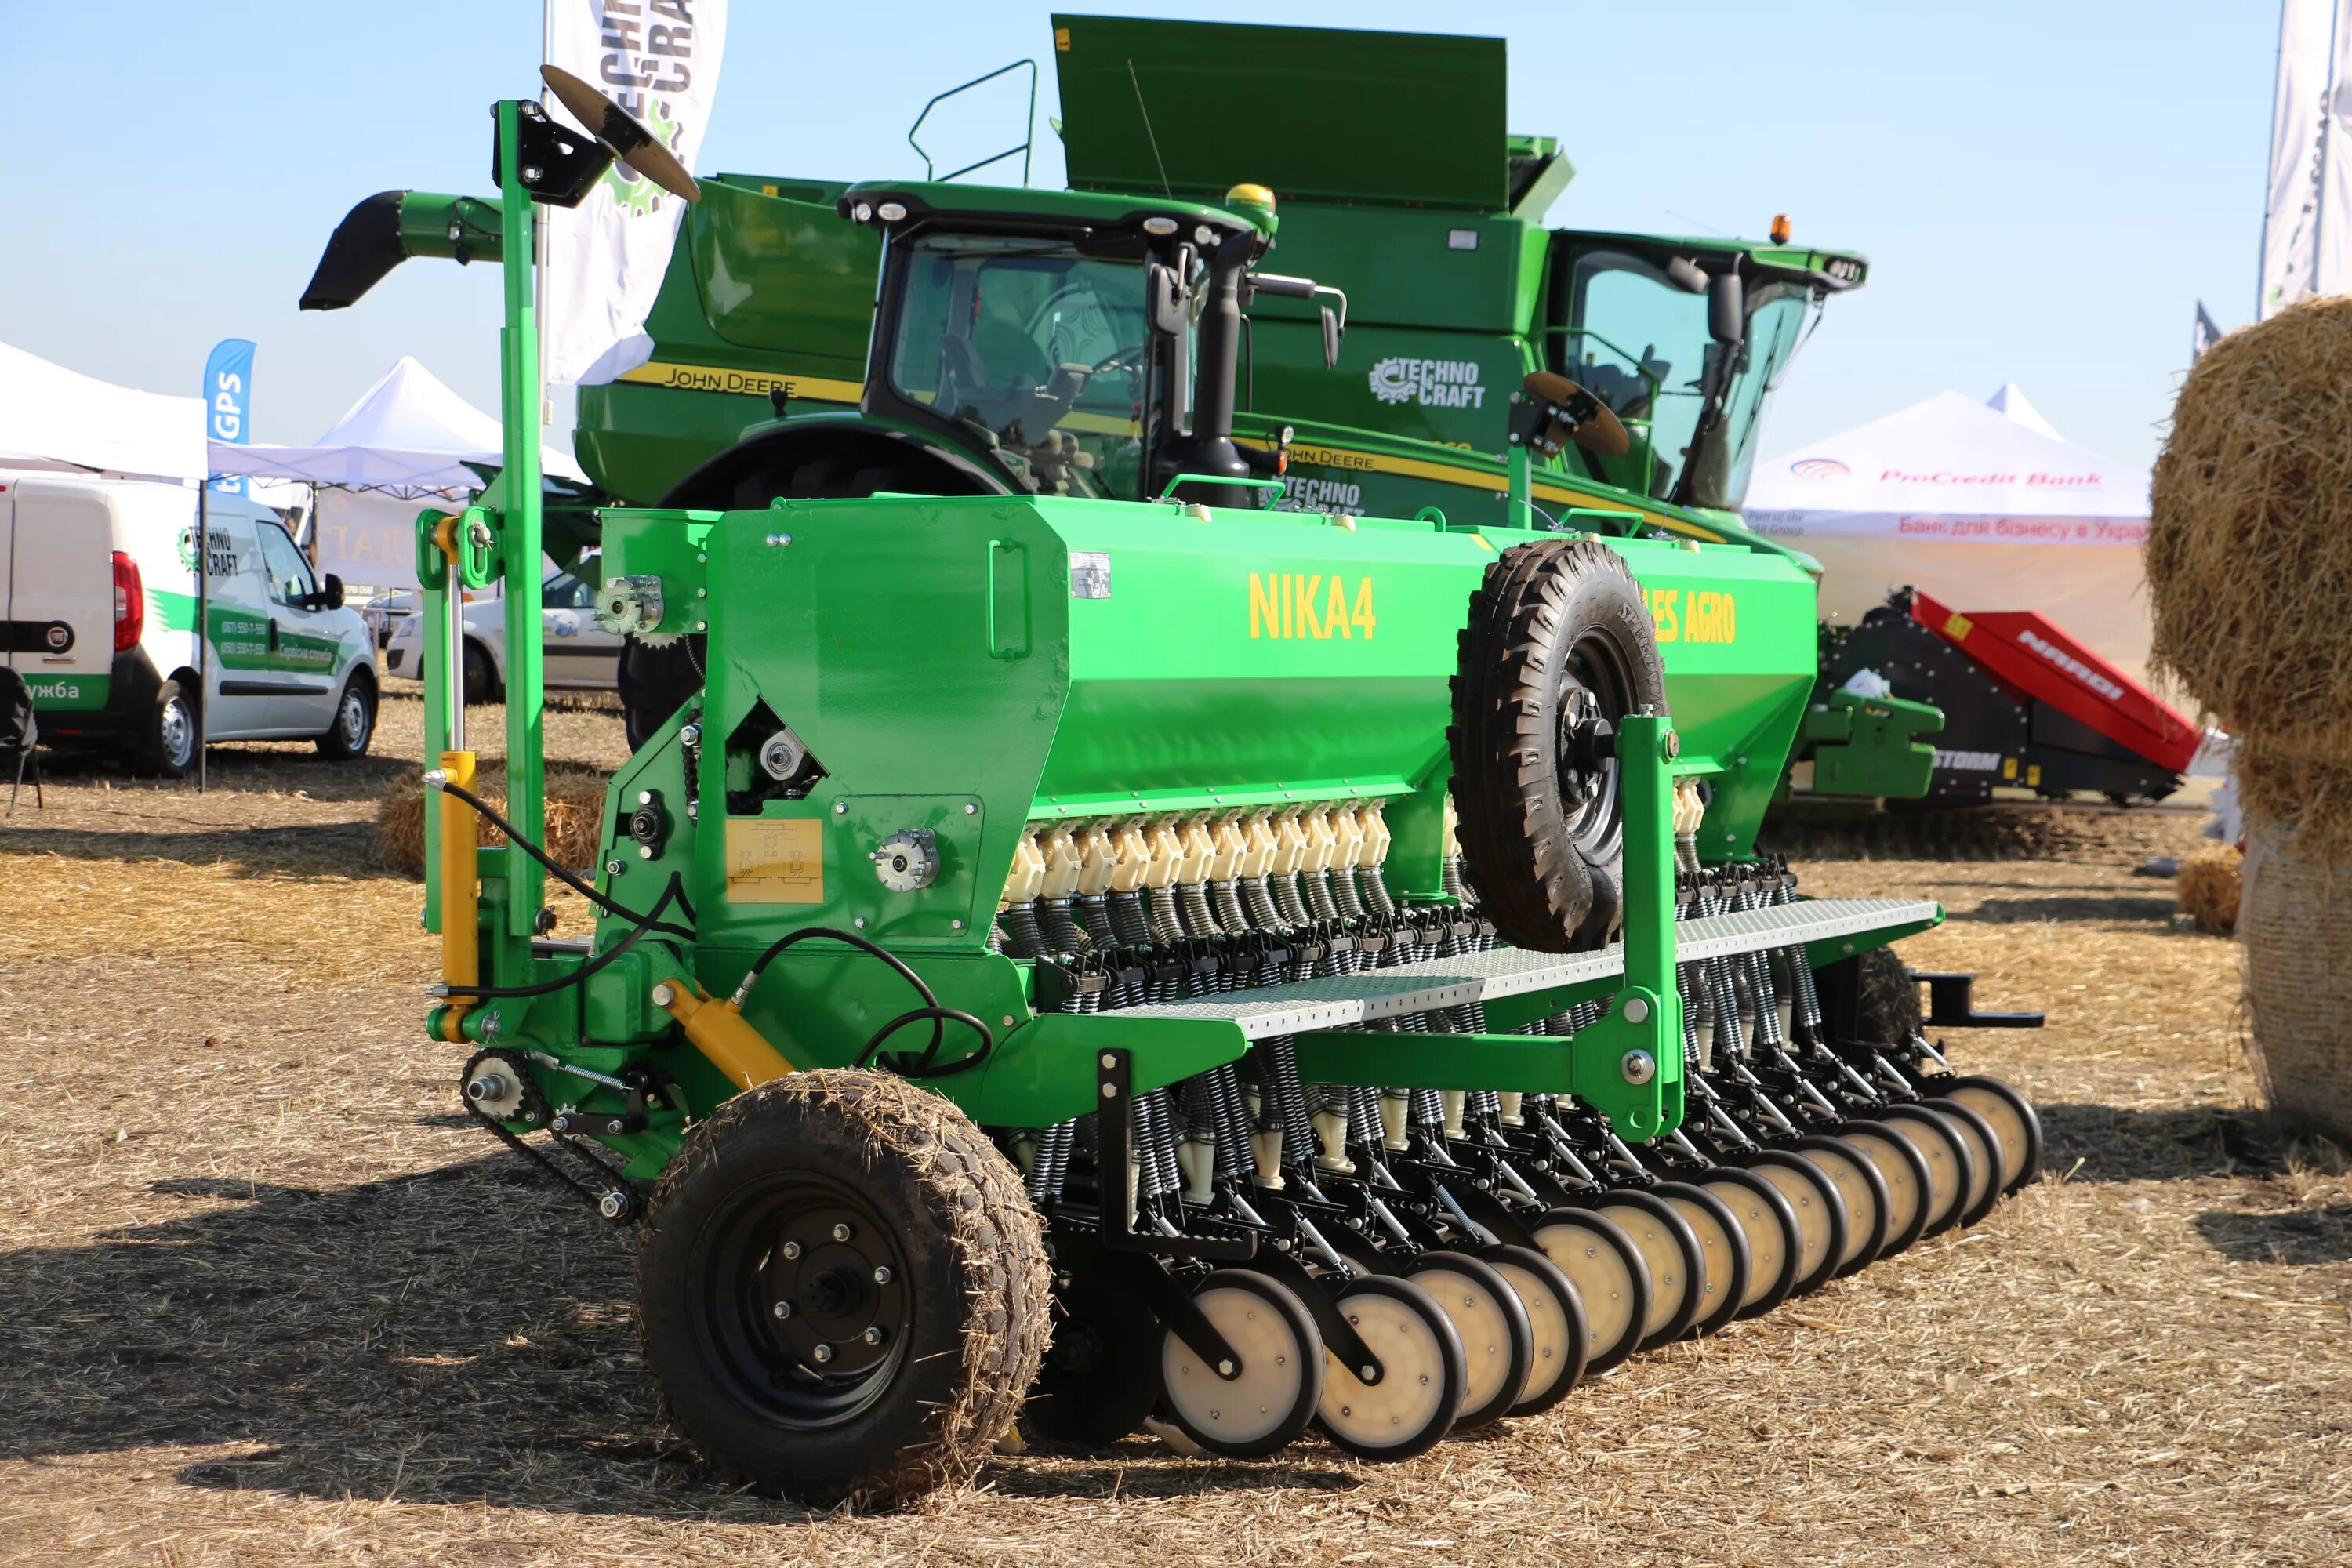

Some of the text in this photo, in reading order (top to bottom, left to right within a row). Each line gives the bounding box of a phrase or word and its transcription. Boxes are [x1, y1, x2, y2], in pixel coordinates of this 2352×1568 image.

[665, 368, 797, 395] JOHN DEERE
[1398, 358, 1479, 389] TECHNO
[215, 372, 241, 440] GPS
[1418, 383, 1486, 408] CRAFT
[1283, 447, 1374, 469] OHN DEERE
[1285, 475, 1361, 508] TECHNO
[1880, 469, 2103, 487] ProCredit Bank
[188, 526, 231, 551] TEHNO
[1898, 516, 1946, 535] Банк
[1249, 572, 1377, 640] NIKA4
[1684, 590, 1736, 644] AGRO
[2016, 630, 2125, 701] NARDI
[26, 681, 80, 699] ужба
